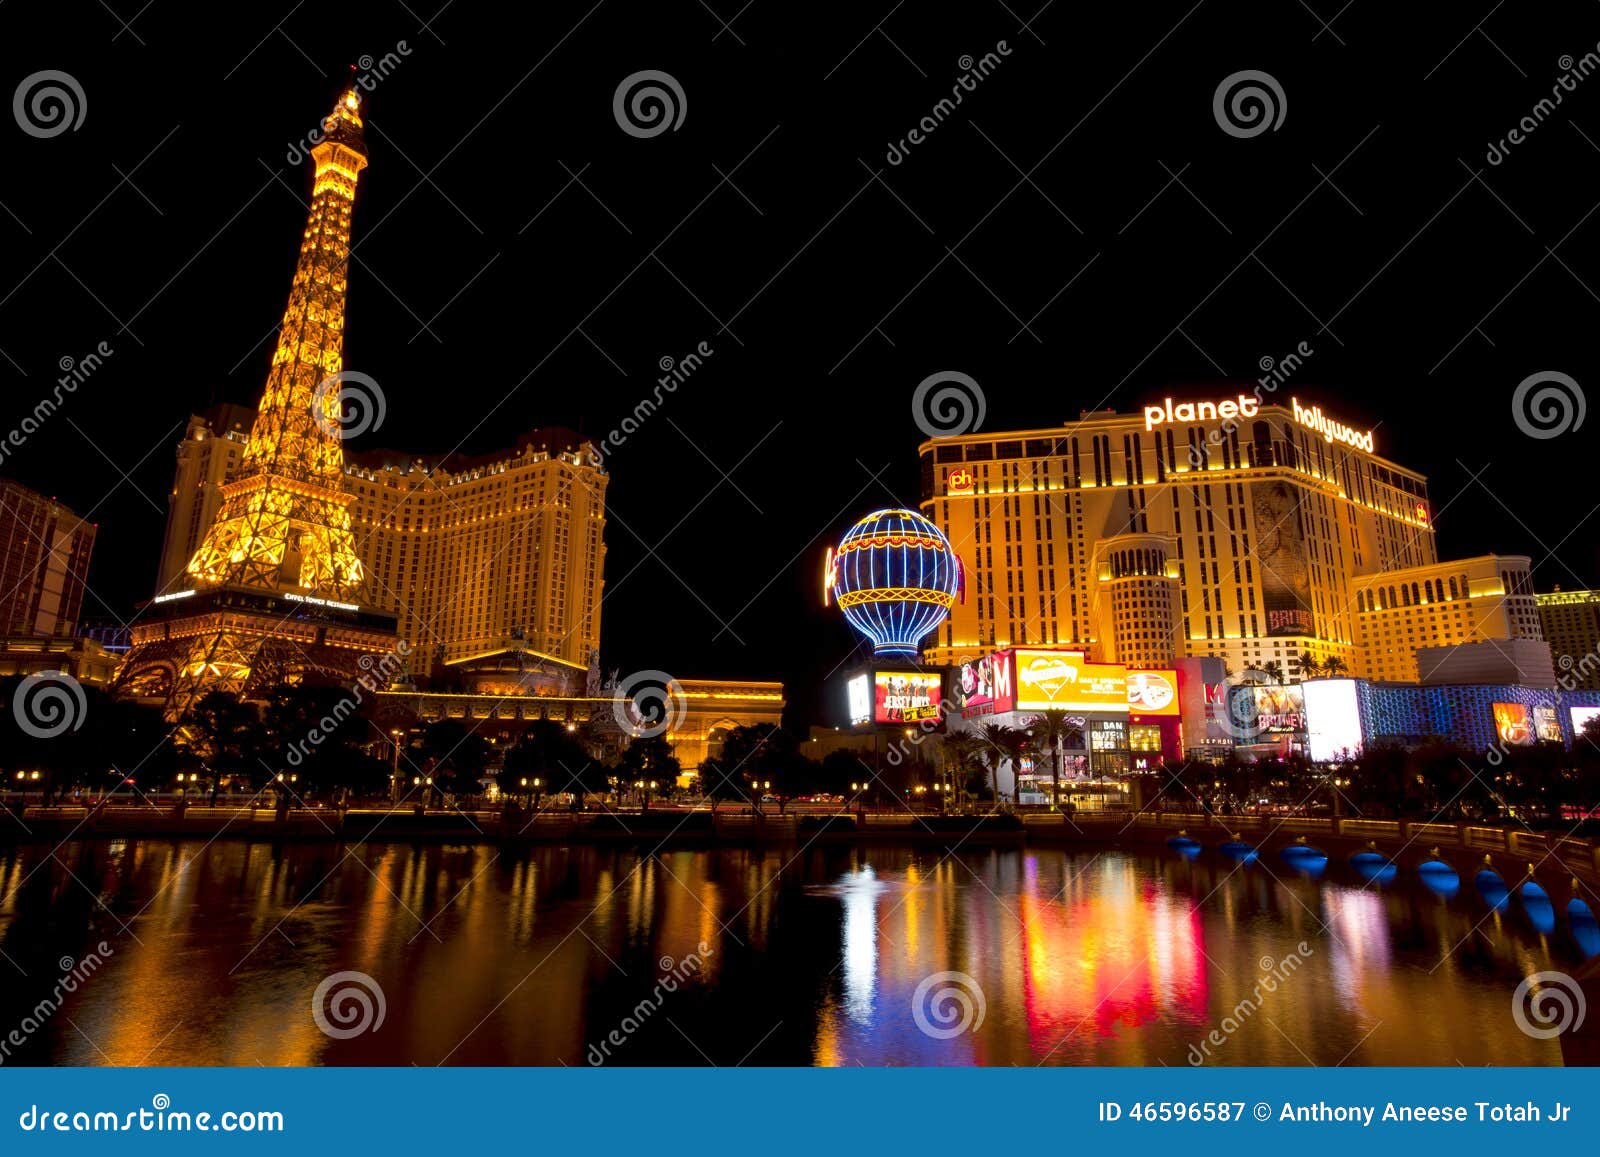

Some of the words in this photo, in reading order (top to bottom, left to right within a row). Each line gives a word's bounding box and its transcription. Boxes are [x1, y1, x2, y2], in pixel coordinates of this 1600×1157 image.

[1144, 395, 1259, 431] planet
[1292, 397, 1374, 453] hollywood
[951, 470, 972, 488] ph
[993, 656, 1011, 700] M
[883, 695, 910, 709] JERSEY
[1203, 683, 1225, 704] M
[1103, 721, 1123, 730] BAN
[1136, 759, 1147, 769] M
